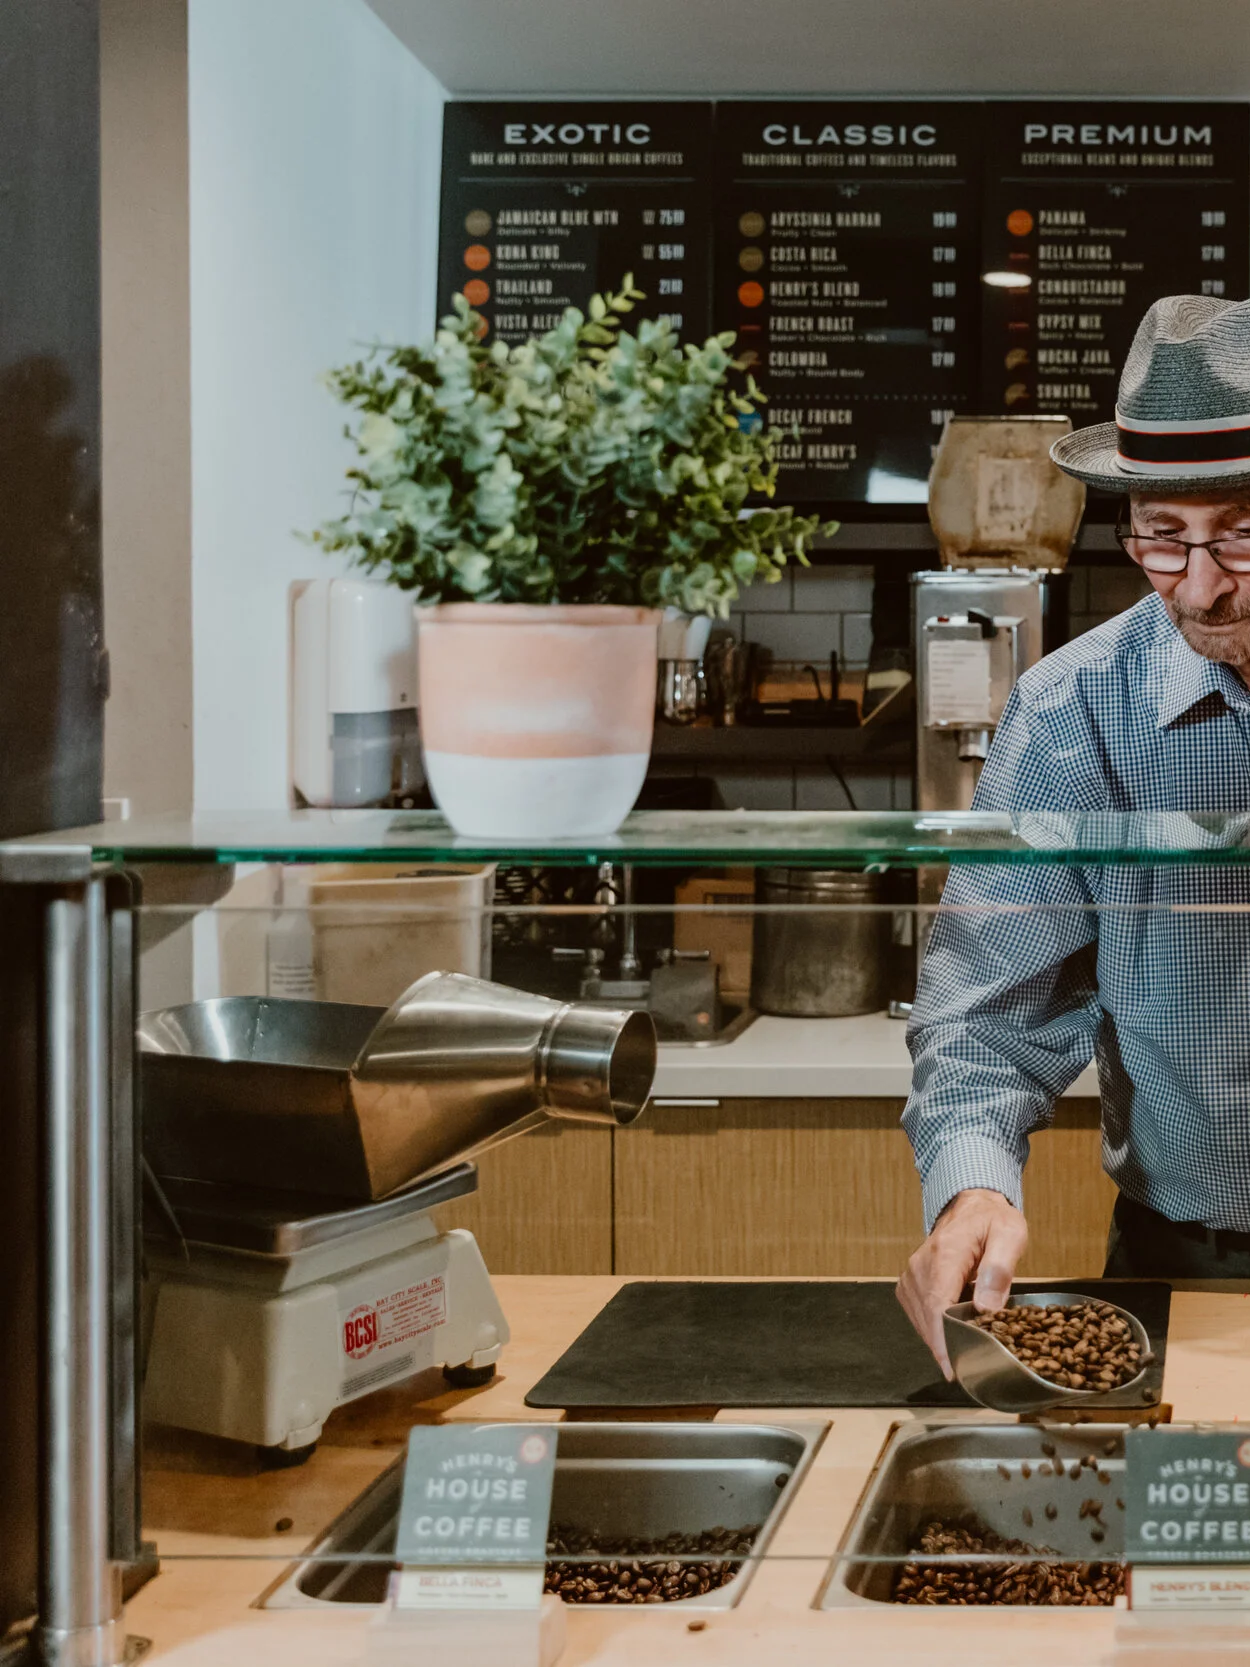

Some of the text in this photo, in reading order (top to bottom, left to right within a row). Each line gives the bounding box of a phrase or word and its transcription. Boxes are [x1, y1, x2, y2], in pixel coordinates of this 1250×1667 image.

[503, 123, 651, 146] EXOTIC
[762, 123, 938, 147] CLASSIC
[1023, 123, 1212, 146] PREMIUM
[497, 209, 619, 226] JAMAICAN BLUE MTN
[771, 212, 832, 228] ABYSSINIA
[496, 244, 527, 260] KONA
[770, 246, 838, 262] COSTA RICA
[1038, 244, 1112, 261] BELLA FINCA
[496, 279, 553, 295] THAILAND
[770, 281, 860, 297] HENRY'S BLEND
[494, 313, 529, 331] VISTA
[769, 315, 814, 332] FRENCH
[1037, 313, 1074, 330] GYPSY
[768, 351, 828, 367] COLOMBIA
[1037, 348, 1111, 365] MOCHA JAVA
[1036, 383, 1091, 400] SUMATRA
[807, 409, 852, 425] FRENCH
[807, 443, 858, 460] HENRY'S
[376, 1296, 389, 1307] BAY
[391, 1290, 406, 1301] CITY
[345, 1311, 377, 1353] BCSI
[440, 1453, 518, 1474] HENRY'S
[1157, 1458, 1238, 1479] HENRY'S
[427, 1478, 528, 1501] HOUSE
[1147, 1482, 1250, 1505] HOUSE
[415, 1515, 531, 1540] COFFEE
[419, 1575, 503, 1589] BELLA FINCA
[1149, 1581, 1205, 1592] HENRY'S
